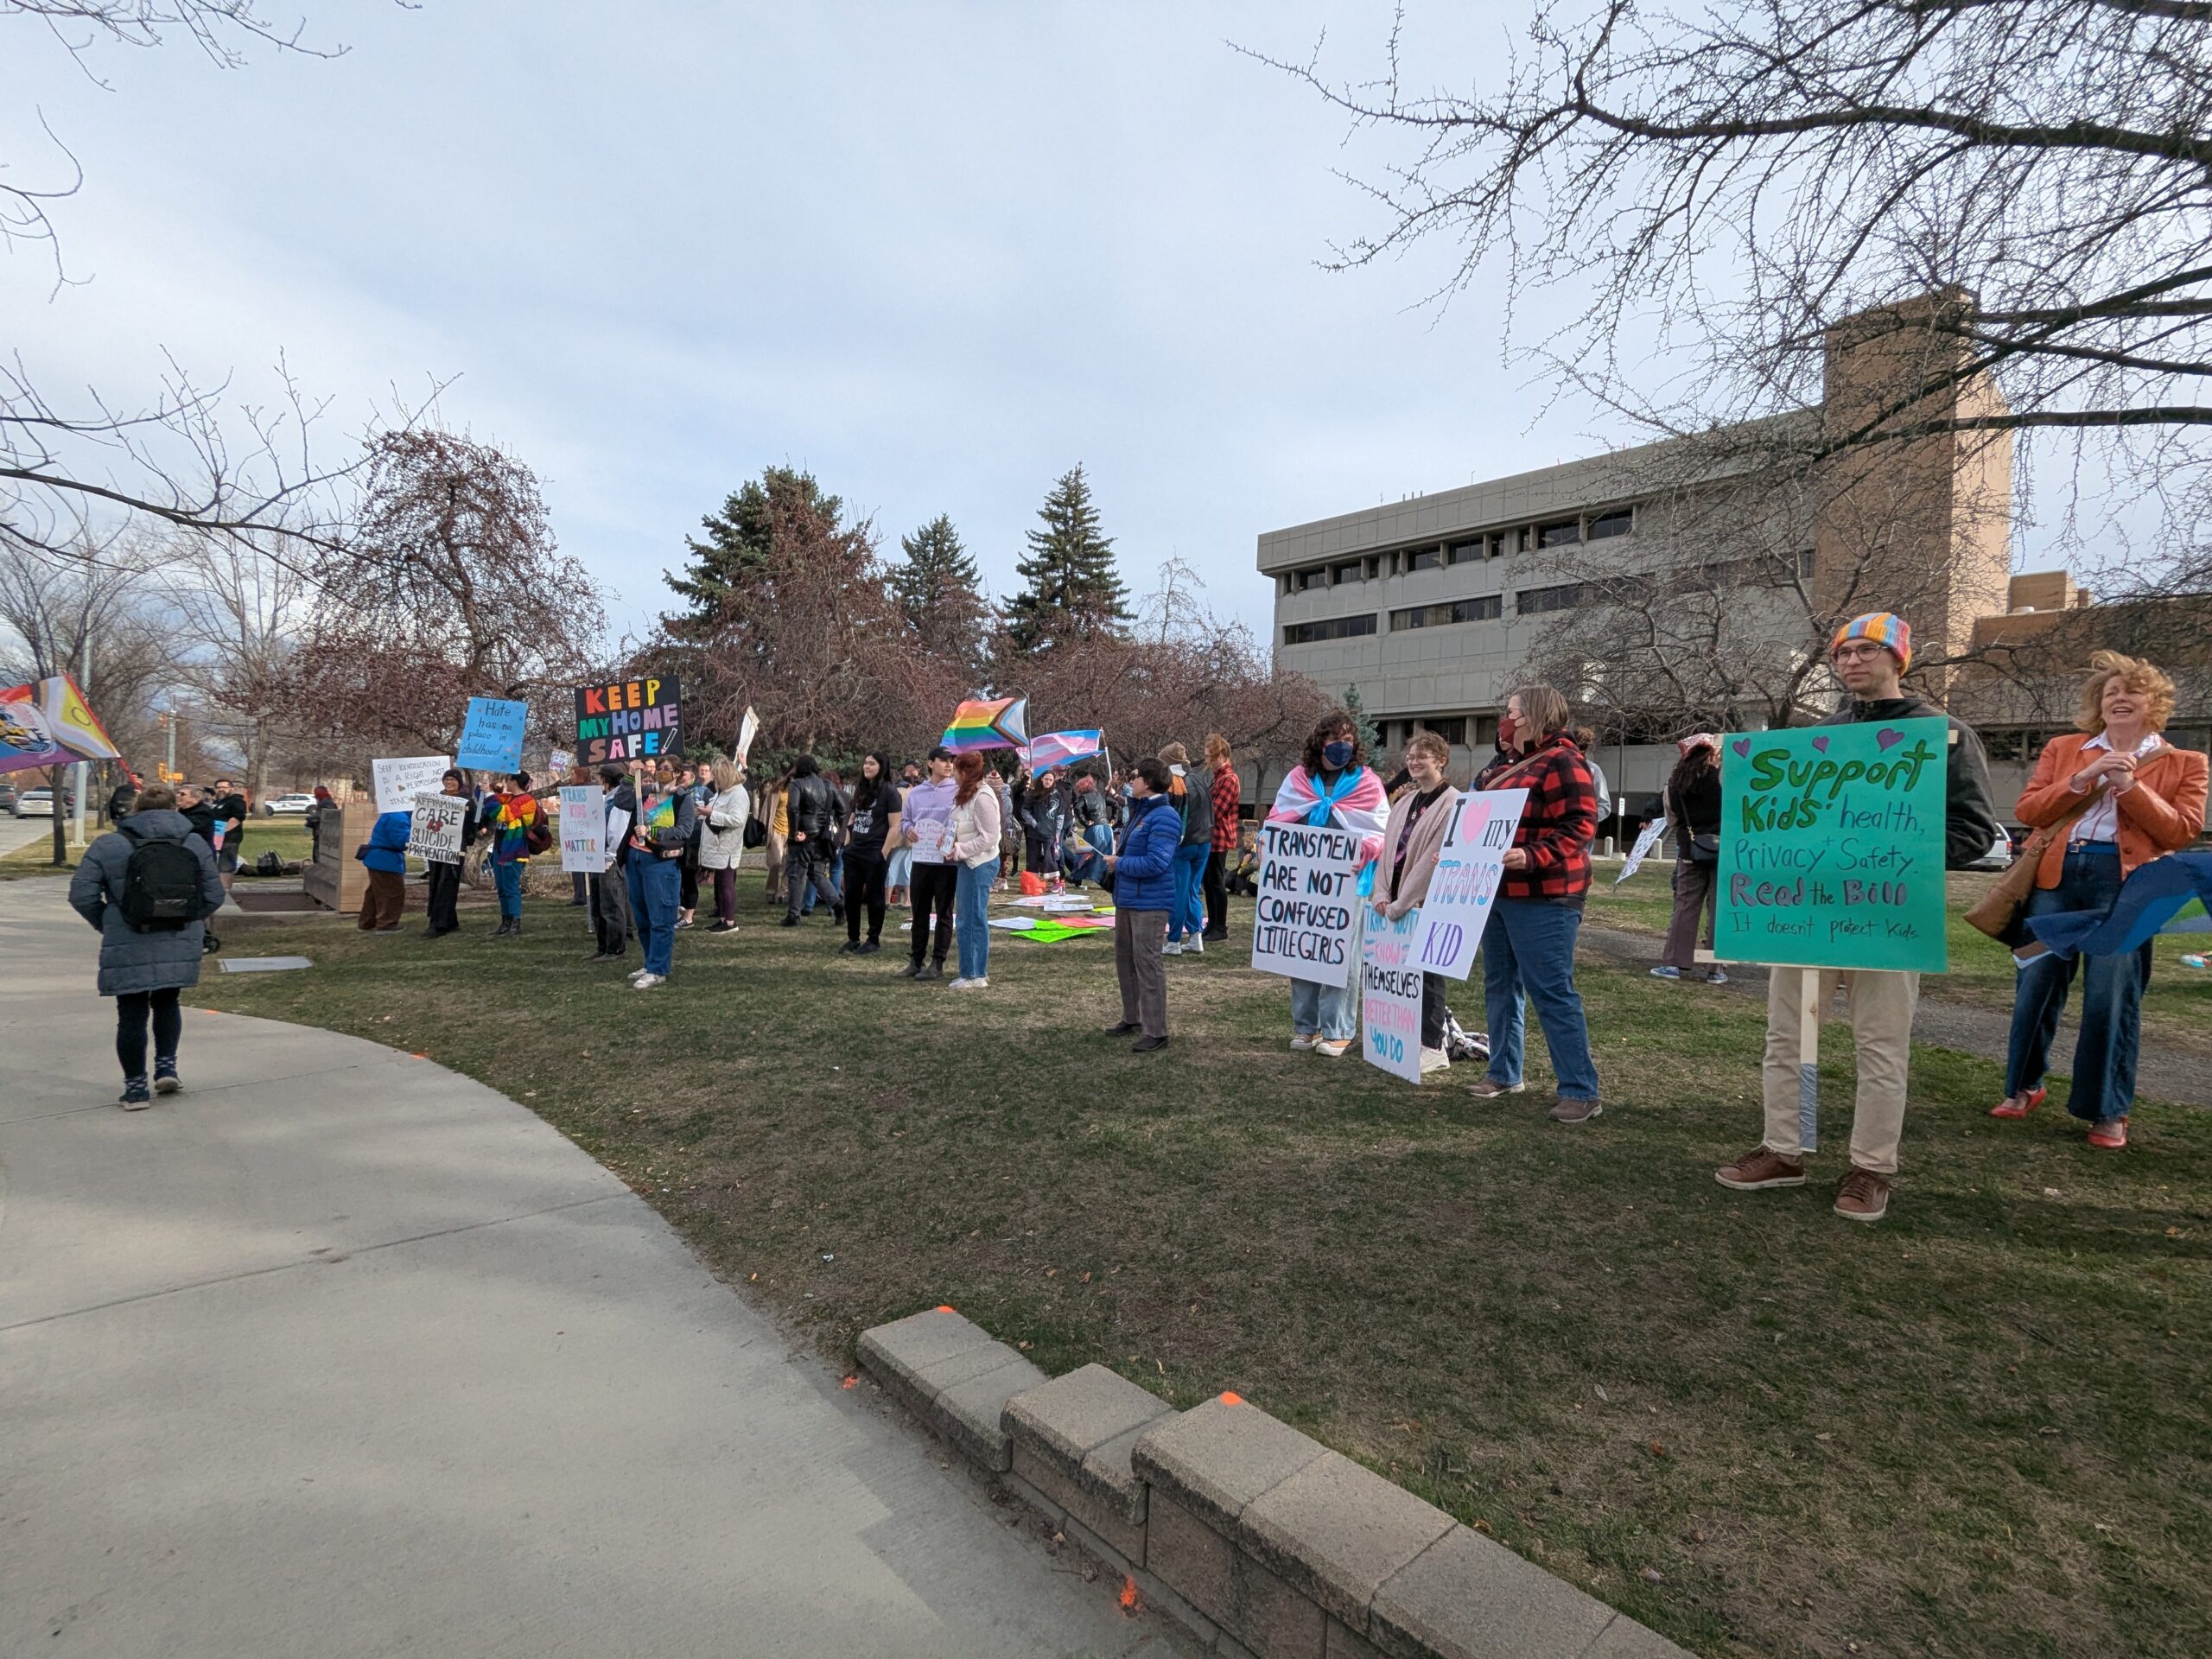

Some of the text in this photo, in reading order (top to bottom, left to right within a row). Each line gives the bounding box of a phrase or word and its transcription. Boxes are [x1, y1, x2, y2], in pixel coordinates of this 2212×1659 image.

[485, 701, 512, 716] Hate
[586, 679, 660, 714] KEEP
[467, 728, 506, 741] place in
[478, 716, 497, 729] has
[579, 703, 678, 740] MY HOME
[461, 743, 502, 755] childhood
[378, 764, 392, 774] SELF
[405, 771, 423, 780] RIGHT
[433, 767, 445, 776] NOT
[406, 777, 442, 790] PERMISSION
[1750, 739, 1937, 800] Support
[416, 797, 463, 812] AFFIRMING
[561, 788, 588, 803] TRANS
[569, 804, 588, 818] KIDS
[416, 807, 460, 825] CARE
[1444, 798, 1517, 850] I my
[1839, 793, 1925, 836] health,
[408, 843, 460, 862] PREVENTION
[411, 828, 455, 850] SUICIDE
[564, 838, 596, 854] MATTER
[1735, 838, 1826, 874] Privacy
[1835, 837, 1918, 877] Safety.
[1262, 860, 1351, 898] ARE NOT
[1433, 859, 1498, 906] TRANS
[1730, 872, 1908, 907] Read the Bill
[1258, 895, 1350, 931] CONFUSED
[1729, 912, 1753, 933] It
[1767, 913, 1815, 938] doesn't
[1830, 917, 1880, 944] protect
[1421, 921, 1463, 967] KID
[1363, 962, 1421, 999] THEMSELVES
[1364, 997, 1415, 1035] BETTER THAN
[1370, 1025, 1403, 1064] YOU DO
